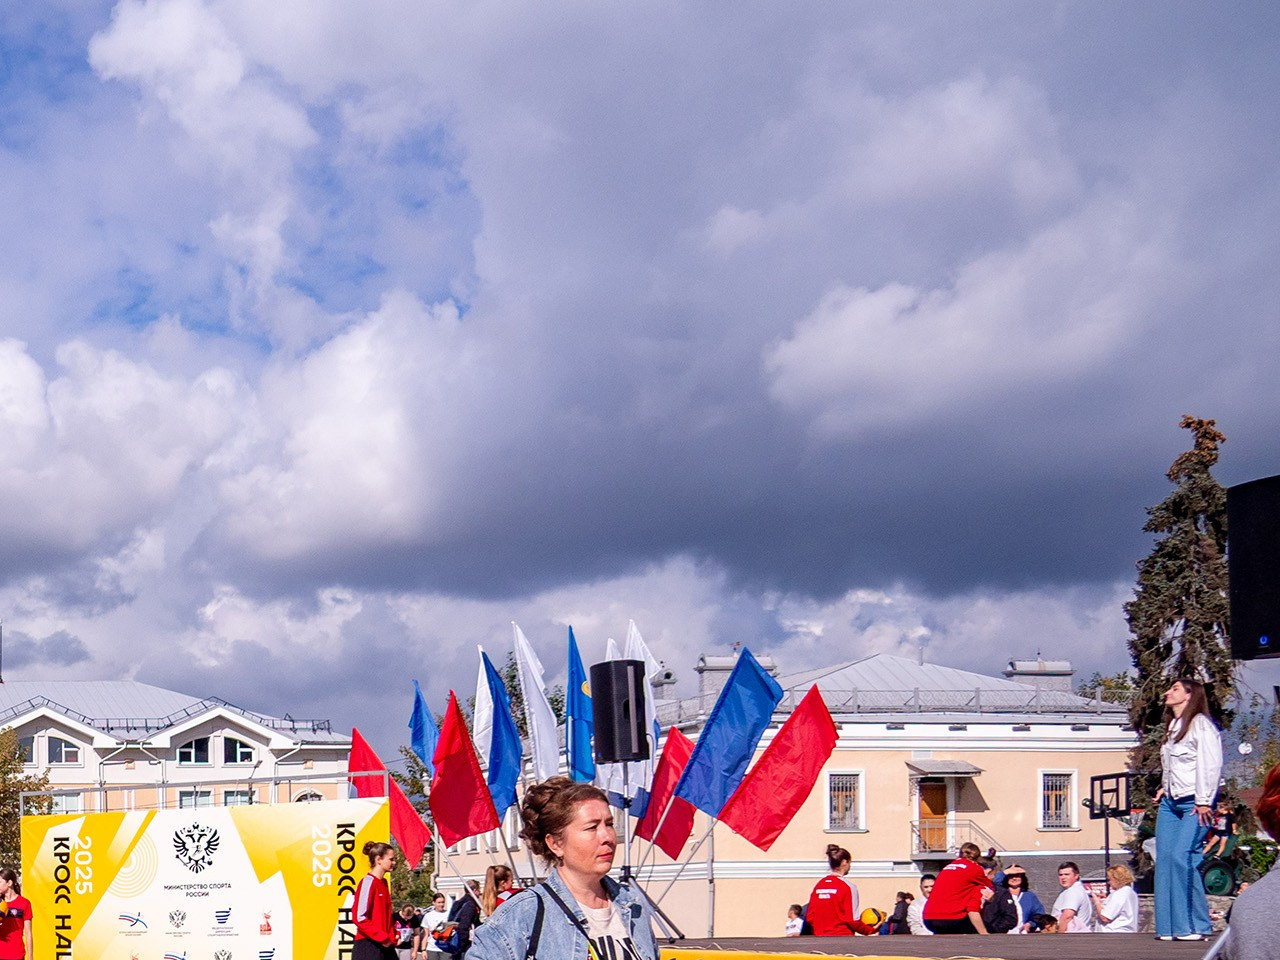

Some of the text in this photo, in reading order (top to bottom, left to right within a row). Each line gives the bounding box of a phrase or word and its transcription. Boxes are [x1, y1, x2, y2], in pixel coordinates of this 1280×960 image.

[53, 837, 71, 904] КРОСС
[74, 836, 93, 895] 2025
[312, 824, 332, 888] 2025
[336, 823, 356, 897] КРОСС
